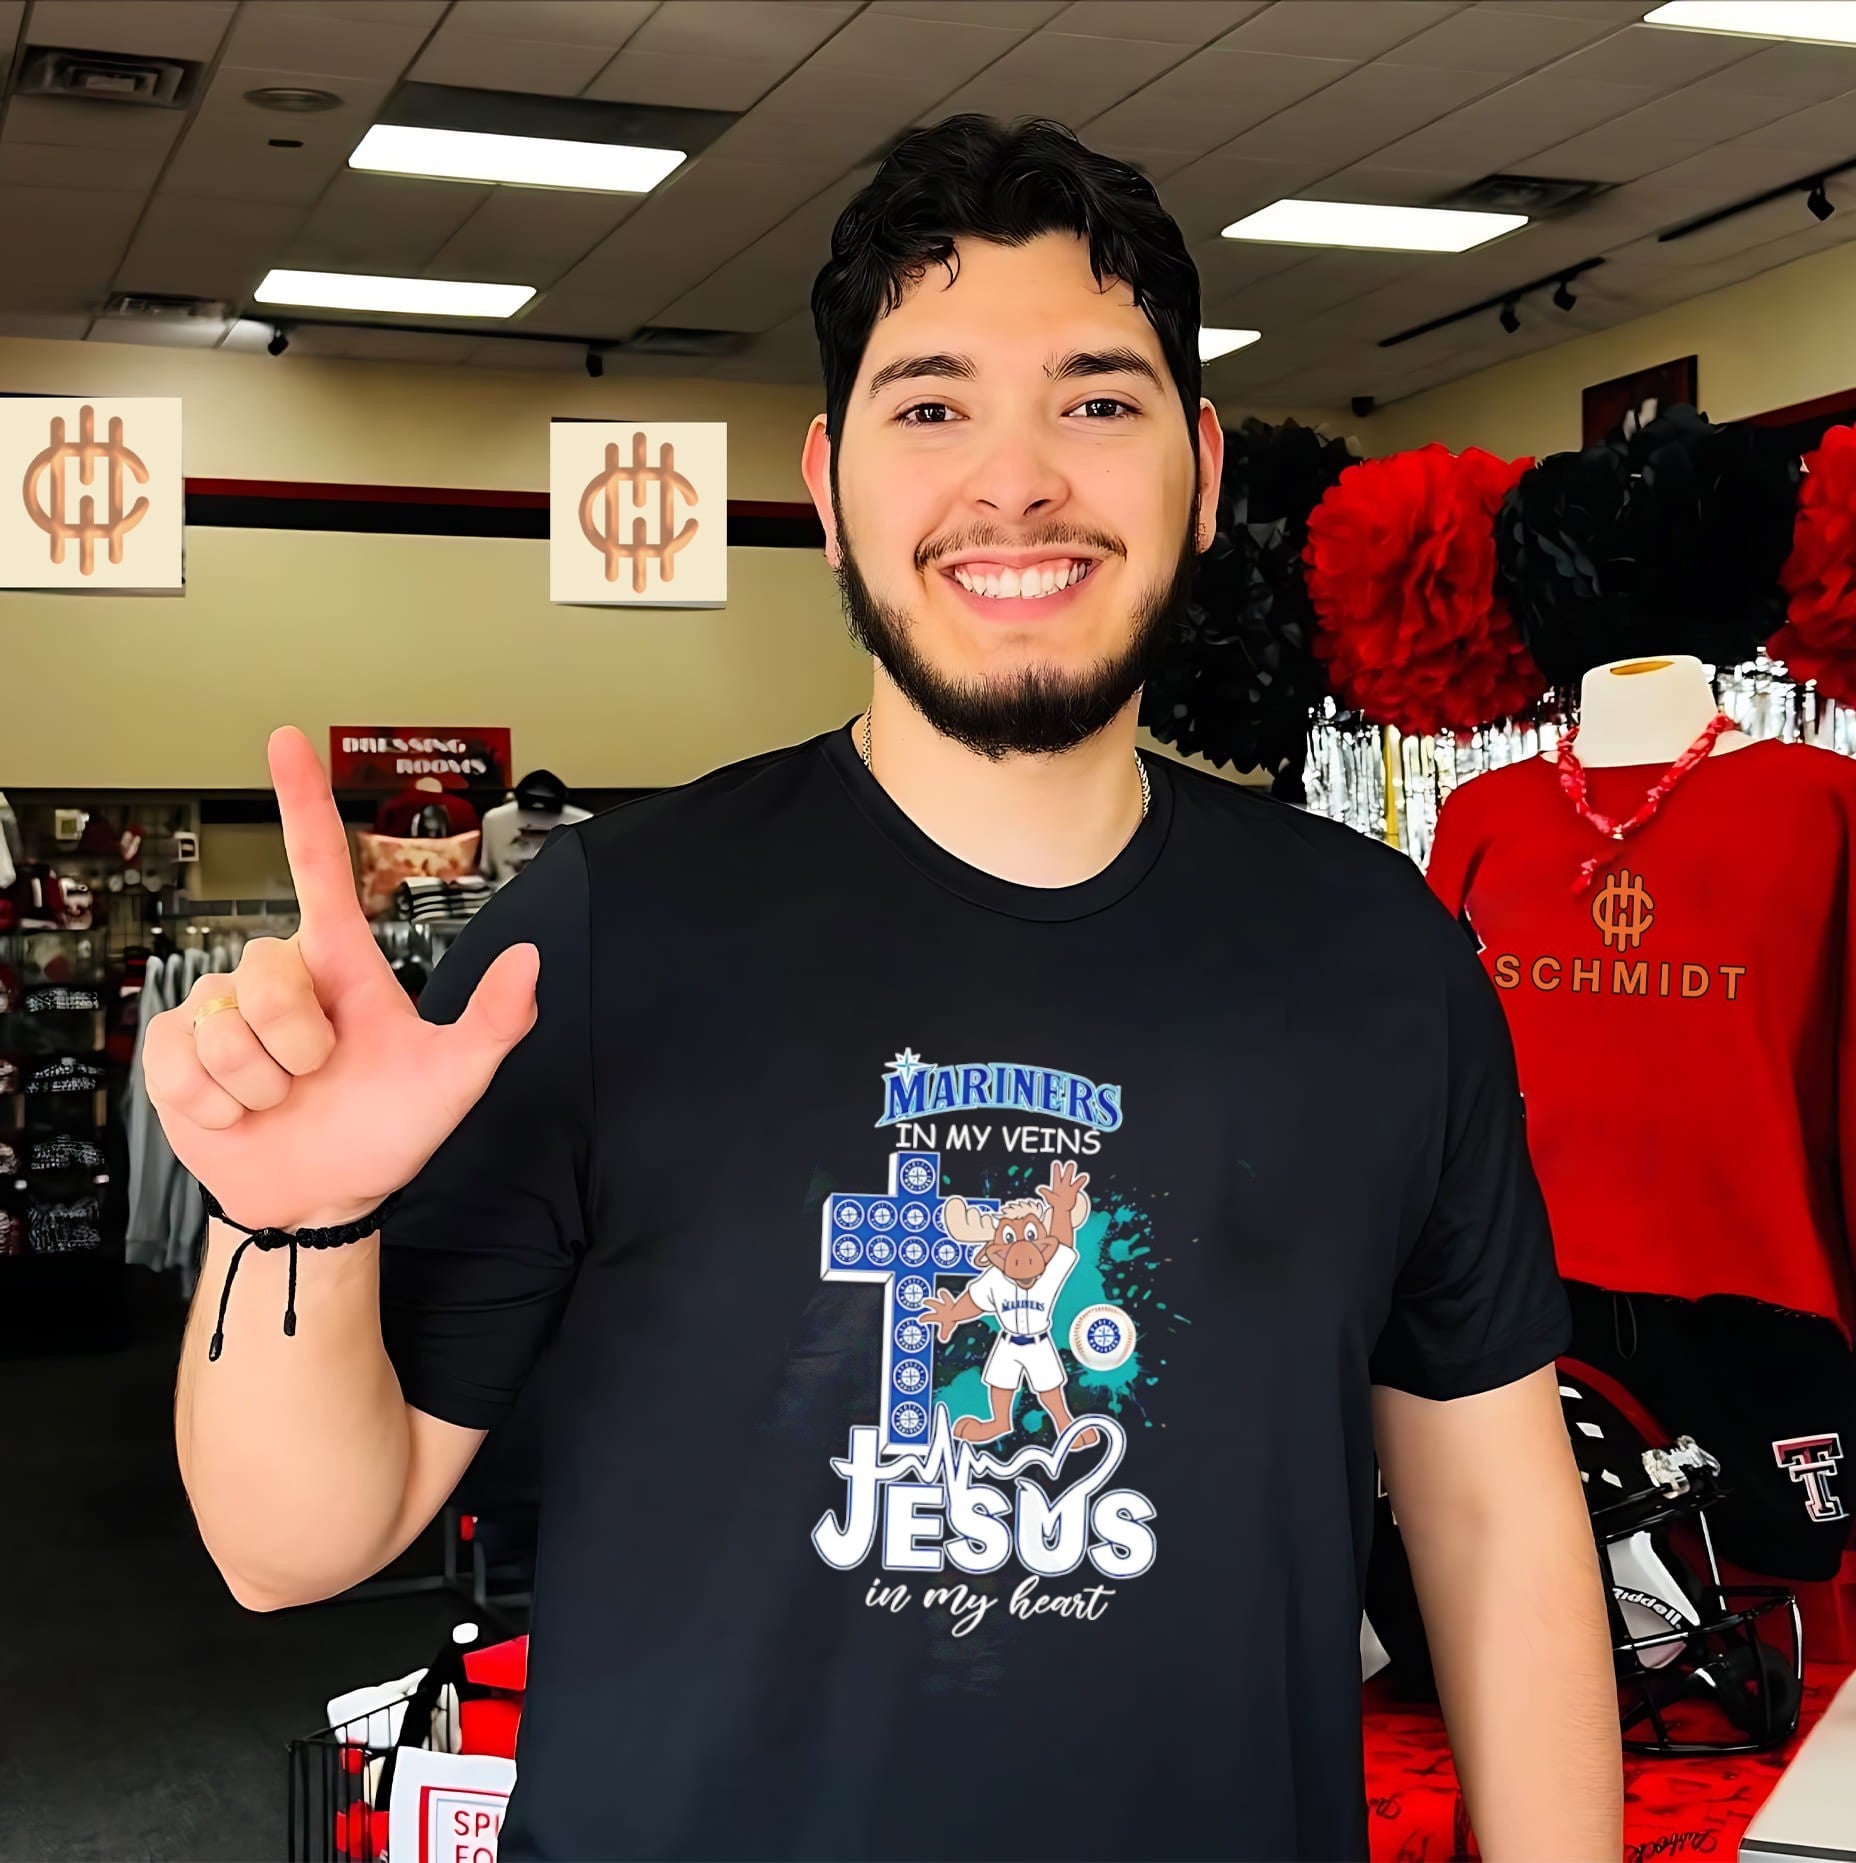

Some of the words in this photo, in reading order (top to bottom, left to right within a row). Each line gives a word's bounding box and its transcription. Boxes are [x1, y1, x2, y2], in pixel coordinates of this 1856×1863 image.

[396, 758, 487, 775] ROOMS
[1494, 954, 1746, 1000] SCHMIDT
[875, 1060, 1123, 1133] MARINERS
[896, 1122, 937, 1149] IN
[945, 1124, 992, 1152] MY
[1002, 1125, 1101, 1155] VEINS
[811, 1424, 1157, 1577] JESUS
[864, 1577, 912, 1613] in
[922, 1582, 998, 1637] my
[1008, 1575, 1117, 1621] heart
